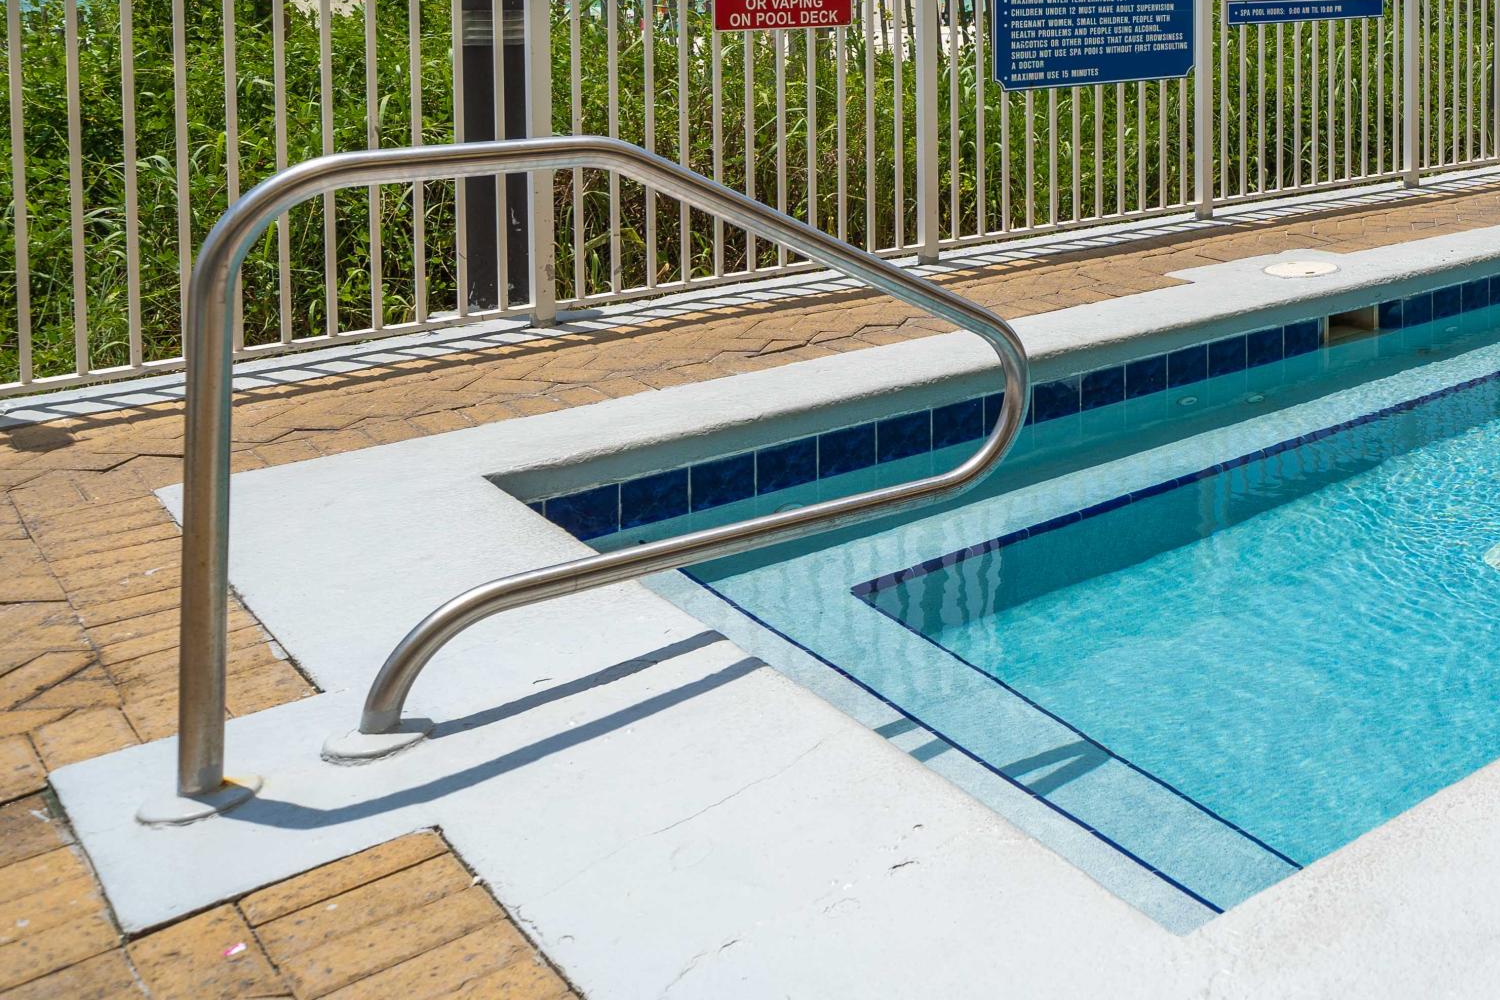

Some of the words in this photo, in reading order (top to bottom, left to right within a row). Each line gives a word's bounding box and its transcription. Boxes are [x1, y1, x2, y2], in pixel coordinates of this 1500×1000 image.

[1011, 8, 1042, 16] CHILDREN
[1137, 4, 1174, 12] SUPERVISION
[730, 13, 750, 27] ON
[756, 12, 795, 26] POOL
[800, 10, 838, 24] DECK
[1011, 20, 1045, 28] PREGNANT
[1011, 30, 1035, 39] HEALTH
[1038, 29, 1071, 37] PROBLEMS
[1011, 40, 1048, 49] NARCOTICS
[1146, 33, 1183, 42] DROWSINESS
[1011, 51, 1036, 59] SHOULD
[1106, 45, 1132, 54] WITHOUT
[1153, 42, 1187, 50] CONSULTING
[1019, 60, 1044, 69] DOCTOR
[1011, 72, 1044, 81] MAXIMUM
[1047, 71, 1059, 79] USE
[1071, 69, 1098, 77] MINUTES
